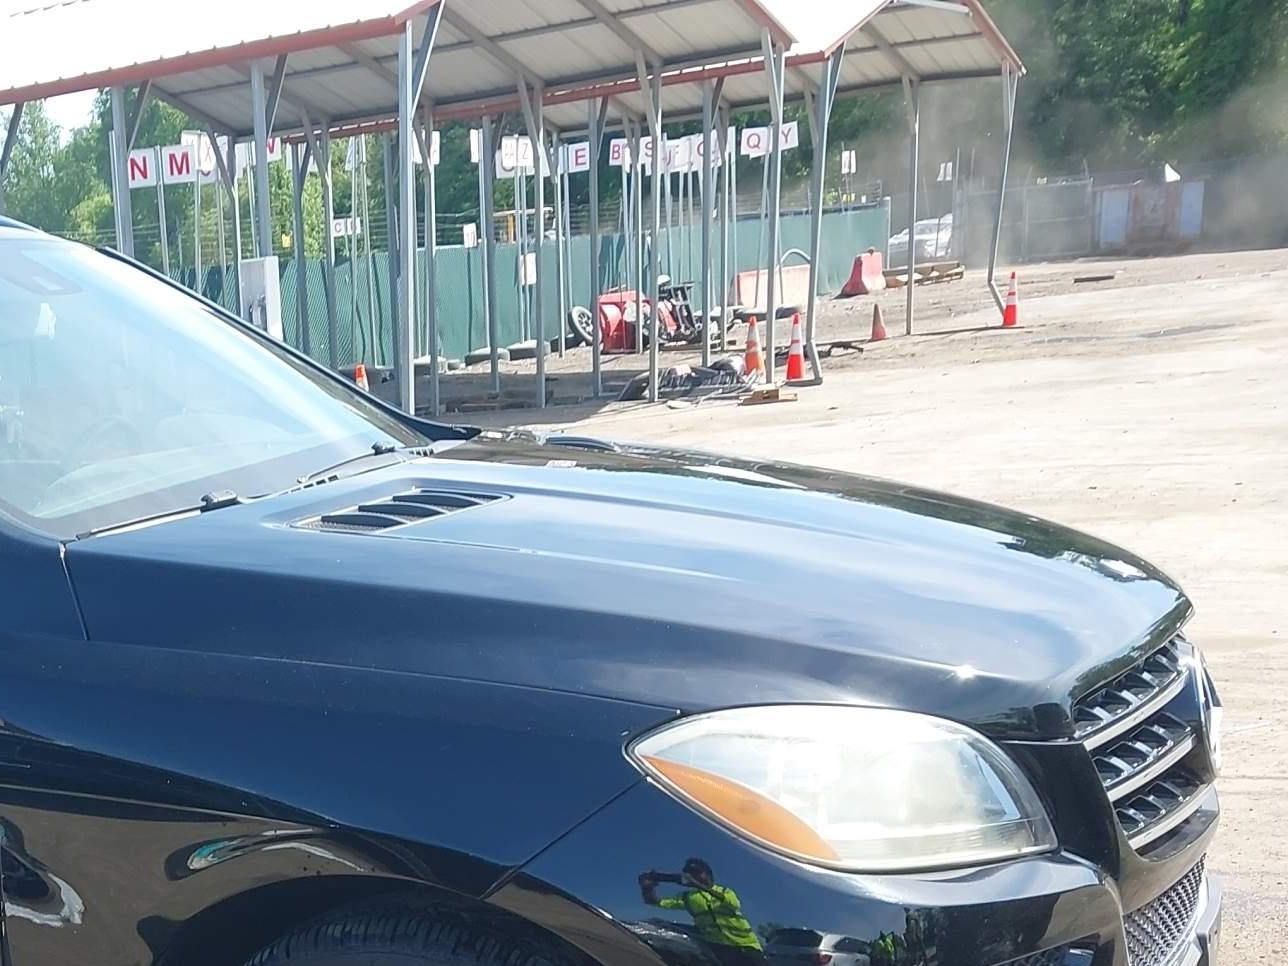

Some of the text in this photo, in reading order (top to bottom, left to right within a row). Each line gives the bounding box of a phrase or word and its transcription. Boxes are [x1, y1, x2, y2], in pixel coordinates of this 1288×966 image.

[746, 132, 761, 149] Q
[781, 127, 792, 143] Y
[574, 147, 587, 166] E
[612, 144, 621, 160] B
[129, 155, 148, 181] N
[168, 151, 190, 176] M
